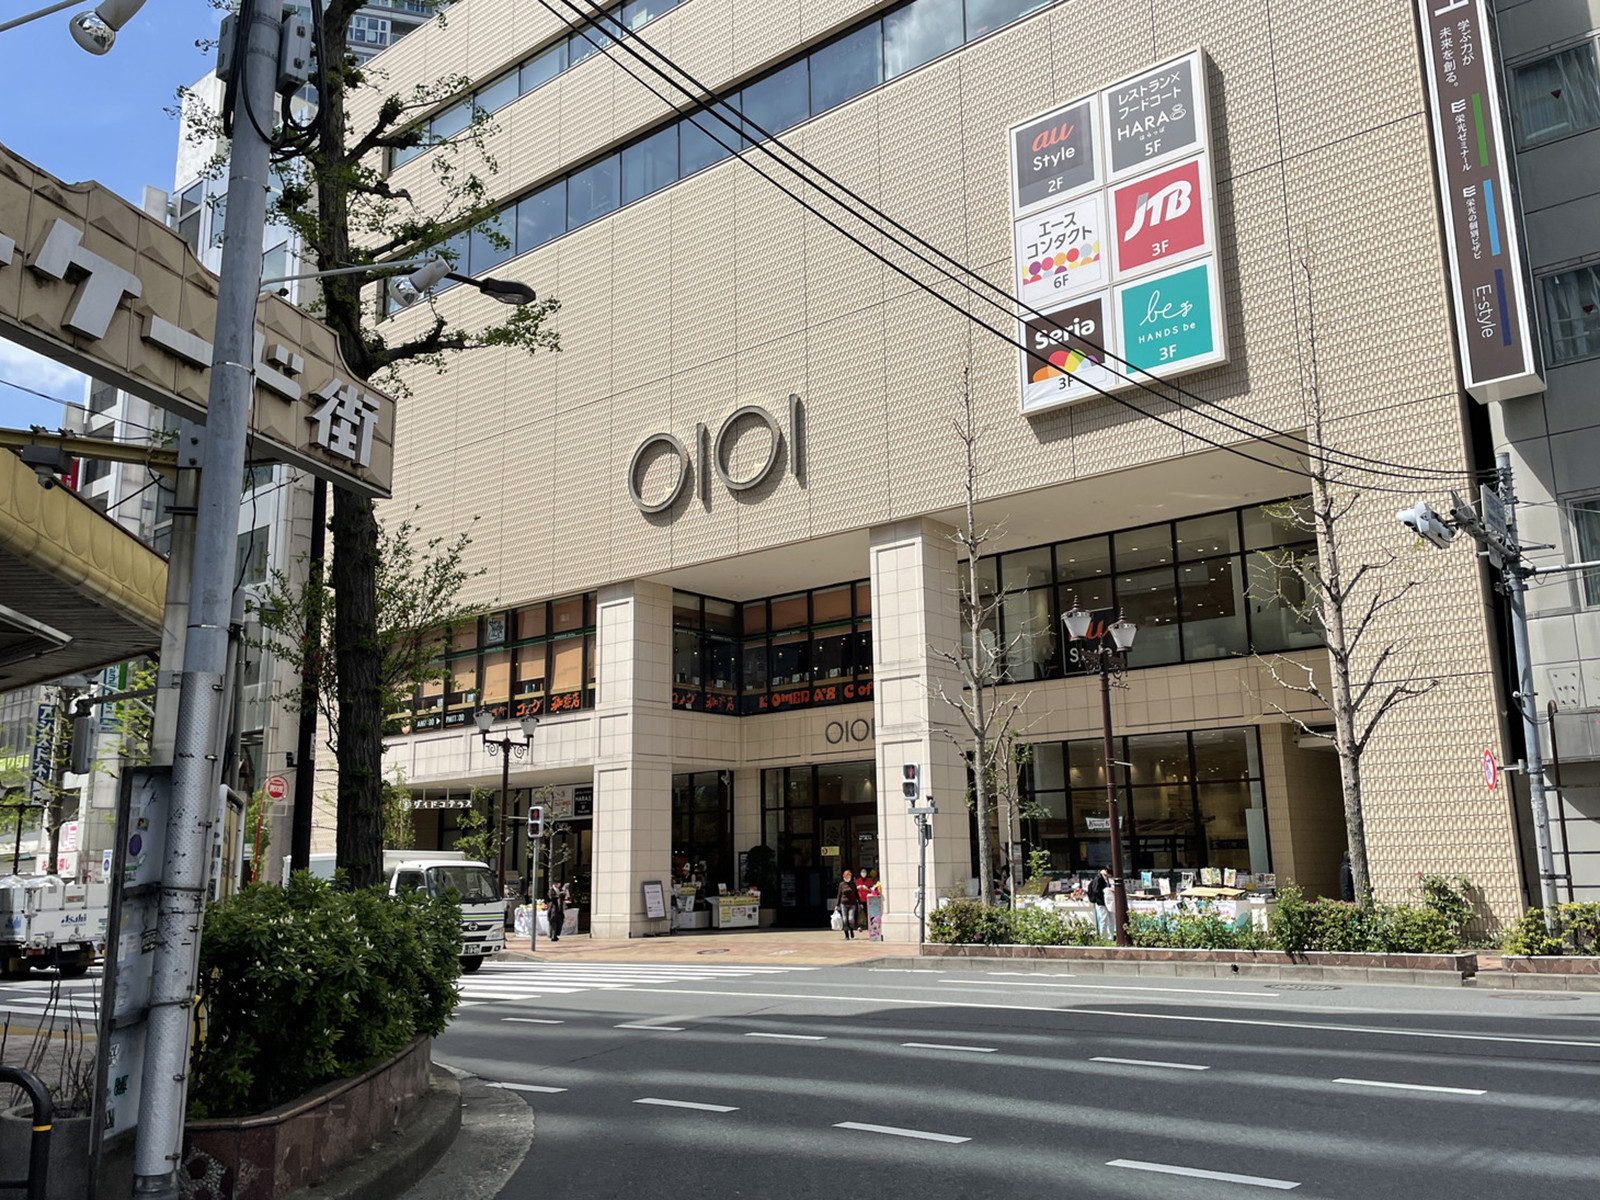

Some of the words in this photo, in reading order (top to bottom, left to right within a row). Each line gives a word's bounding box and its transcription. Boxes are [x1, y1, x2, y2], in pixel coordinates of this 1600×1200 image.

[1457, 19, 1475, 67] 学ぶ力が
[1118, 86, 1182, 120] フードコート
[1031, 122, 1074, 152] au
[1144, 138, 1162, 156] 5F
[1454, 113, 1472, 172] 栄光ゼミナール
[1032, 147, 1076, 171] Style
[1047, 176, 1064, 193] 2F
[1038, 211, 1078, 238] エース
[1123, 180, 1193, 242] JTB
[1026, 226, 1093, 260] コンタクト
[1151, 239, 1170, 257] 3F
[1053, 273, 1070, 290] 6F
[1475, 284, 1497, 338] E-style
[0, 216, 381, 469] ケード街
[1034, 316, 1097, 350] Seria
[1138, 325, 1179, 345] HANDS
[1182, 321, 1197, 333] be
[1159, 344, 1178, 361] 3F
[1058, 373, 1074, 391] 3F
